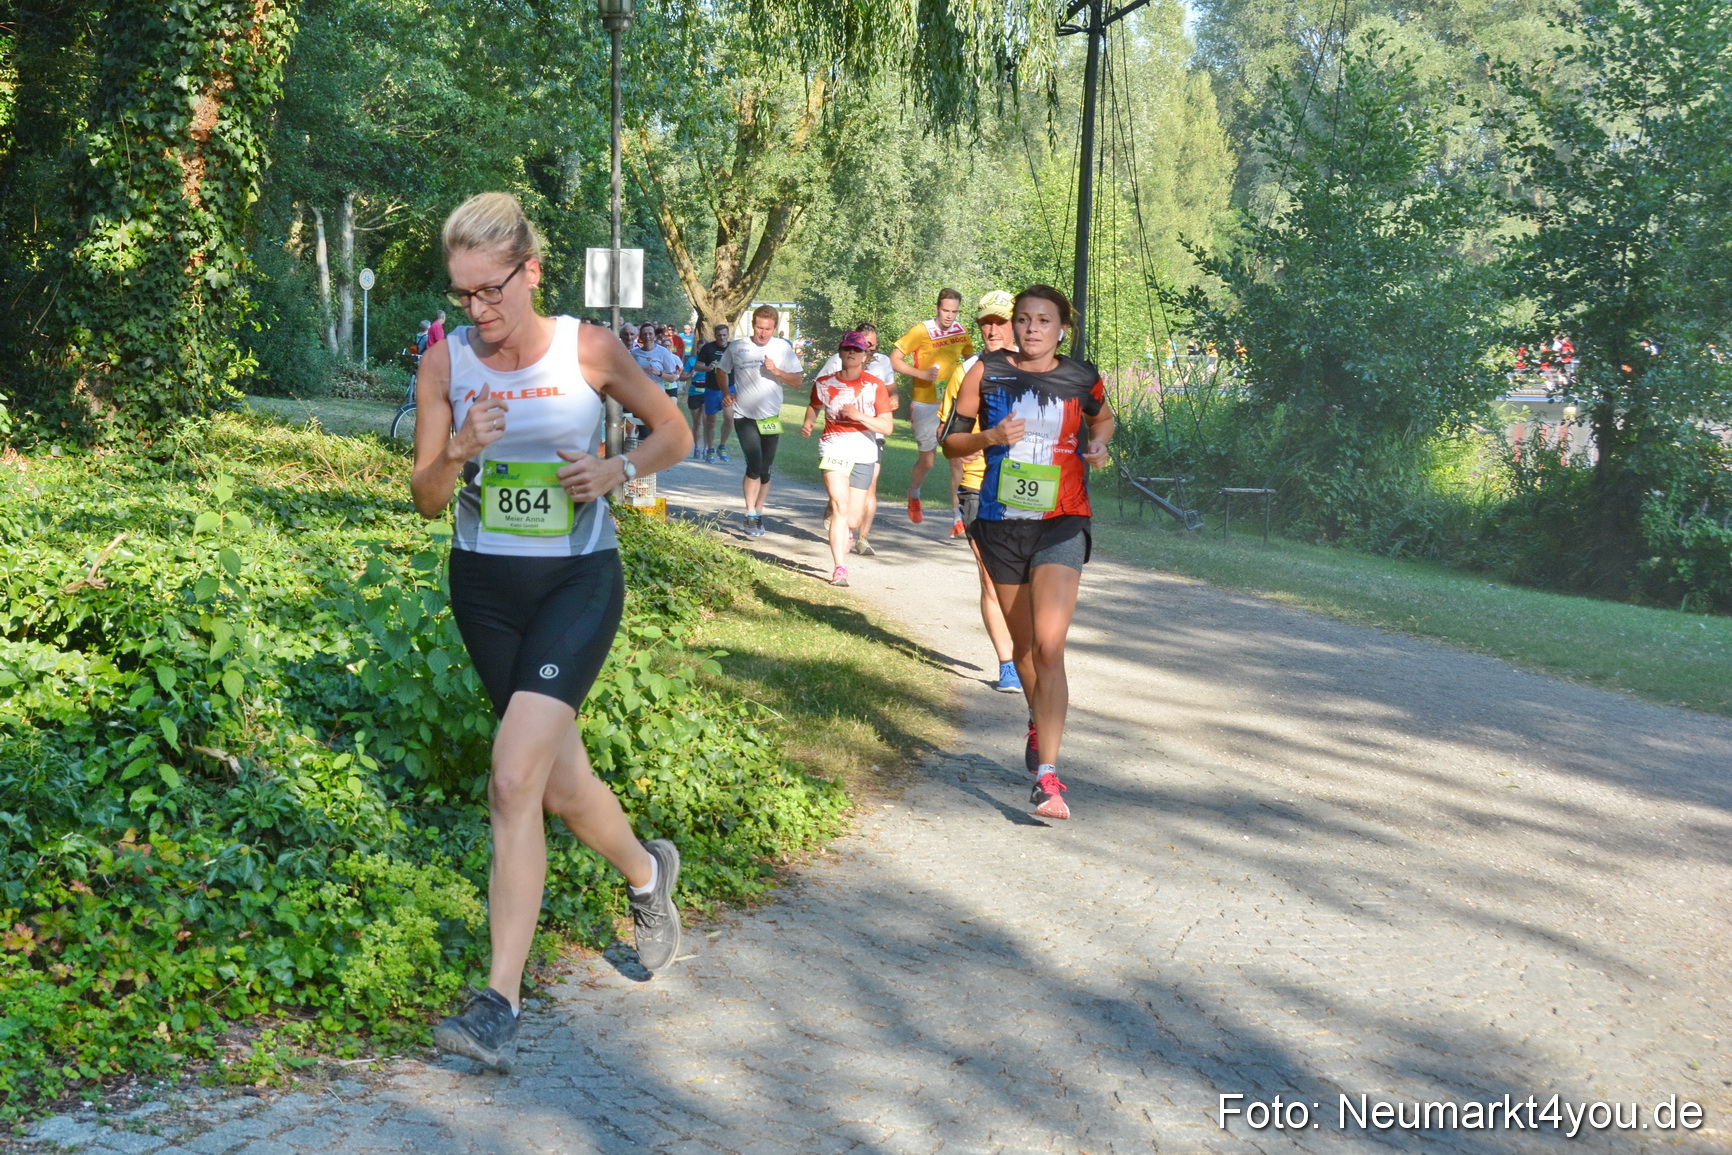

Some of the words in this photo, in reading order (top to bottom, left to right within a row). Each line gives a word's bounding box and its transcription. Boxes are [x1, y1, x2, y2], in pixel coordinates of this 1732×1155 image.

[490, 386, 566, 400] KLEBL
[1015, 479, 1038, 497] 39
[498, 487, 551, 514] 864
[504, 514, 524, 522] Meier
[525, 515, 545, 523] Anna
